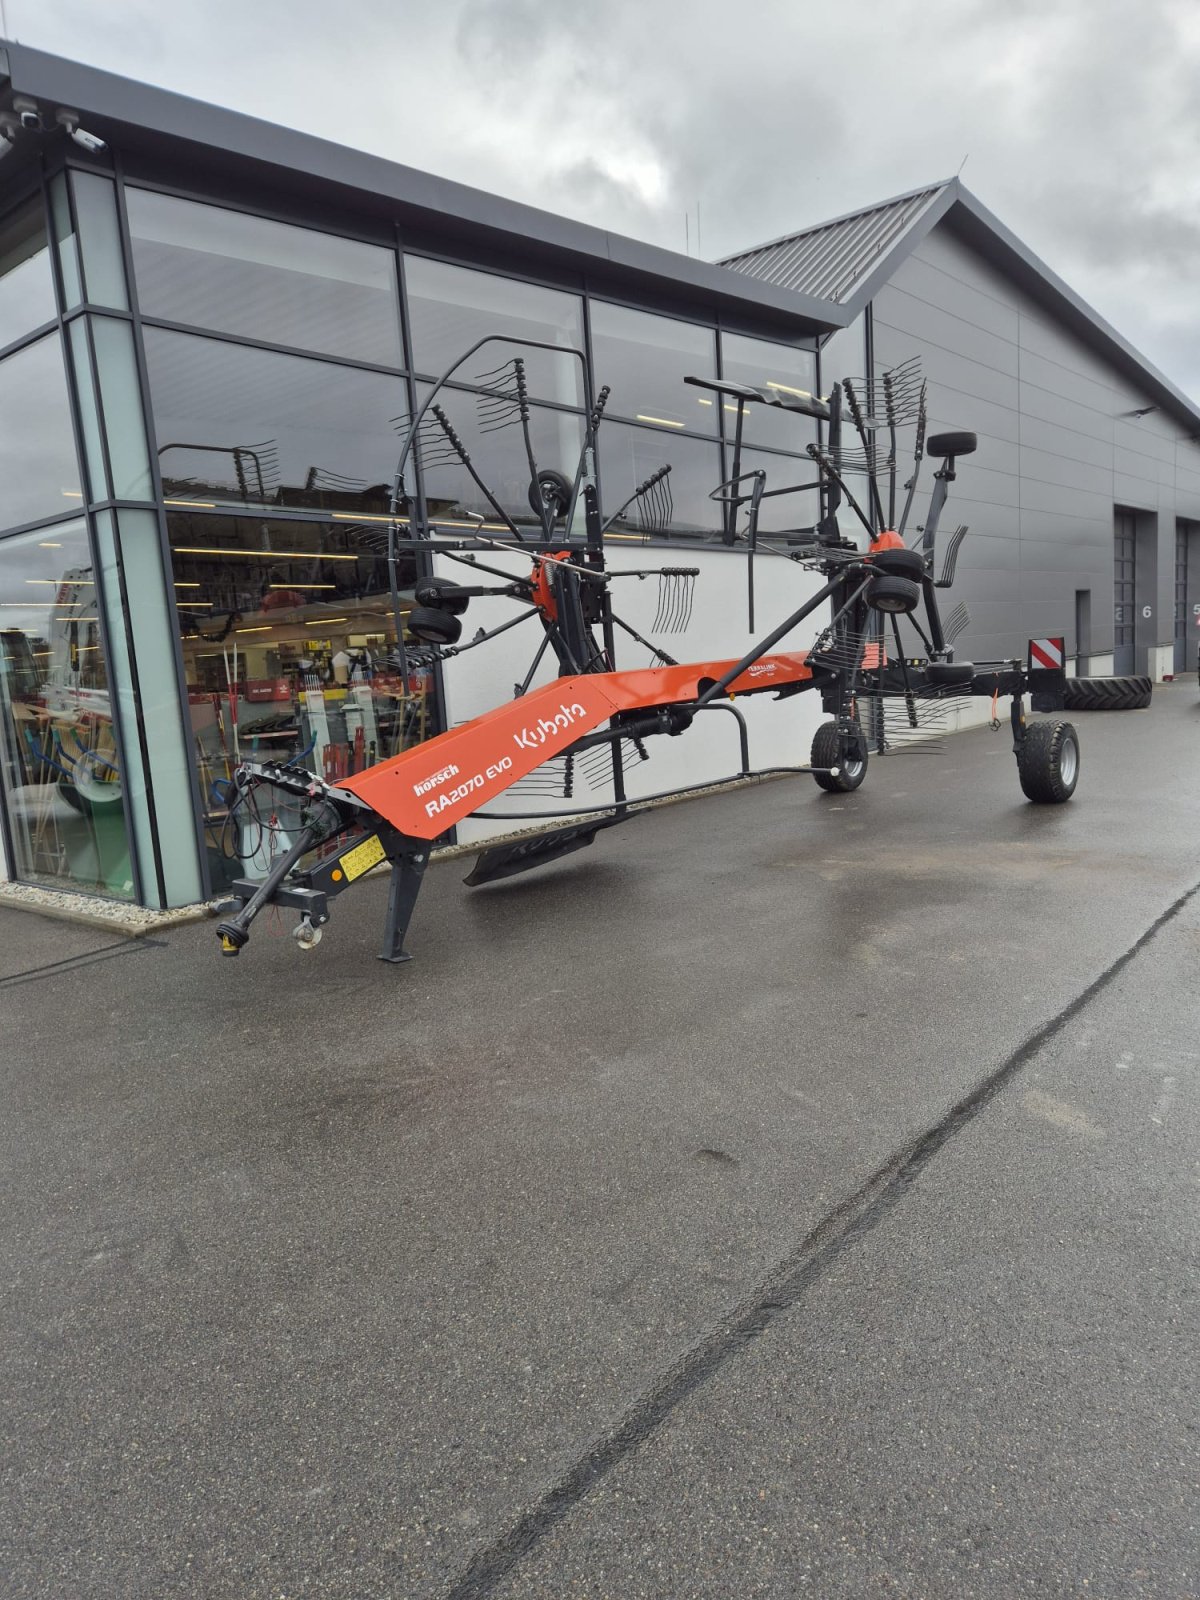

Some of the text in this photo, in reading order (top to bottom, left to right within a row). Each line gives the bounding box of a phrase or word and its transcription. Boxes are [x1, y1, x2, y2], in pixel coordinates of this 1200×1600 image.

[1142, 605, 1152, 618] 6
[1193, 604, 1200, 615] 5
[513, 703, 587, 749] Kubota
[413, 764, 460, 797] horsch
[424, 773, 485, 818] RA2070
[485, 756, 513, 779] EVO
